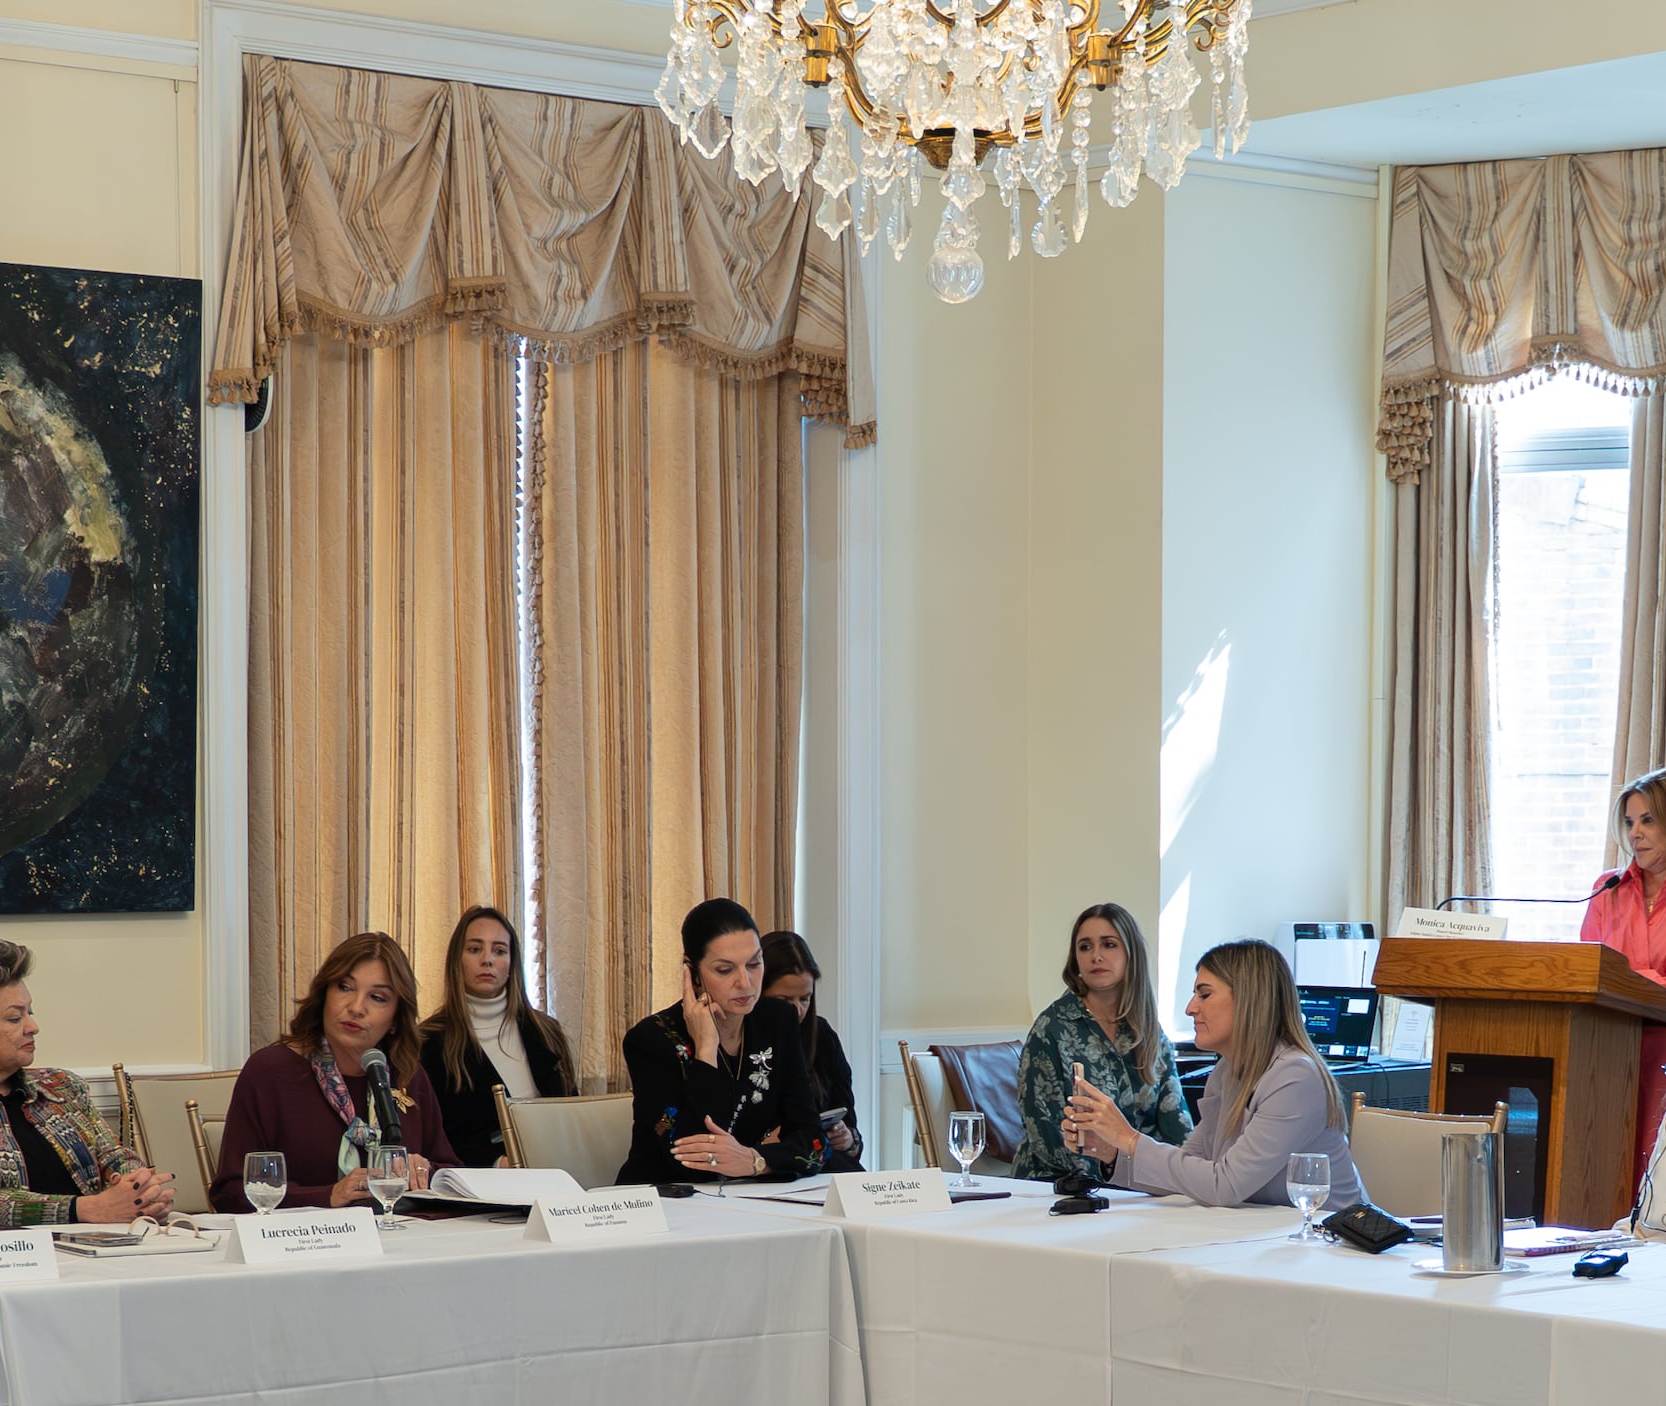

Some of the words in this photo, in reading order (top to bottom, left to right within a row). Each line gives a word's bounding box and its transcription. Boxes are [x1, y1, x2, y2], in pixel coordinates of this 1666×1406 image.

[548, 1205, 582, 1217] Maricel
[582, 1203, 610, 1214] Cohen
[611, 1202, 623, 1211] de
[623, 1199, 653, 1210] Mulino
[260, 1225, 309, 1239] Lucrecia
[311, 1222, 357, 1235] Peinado
